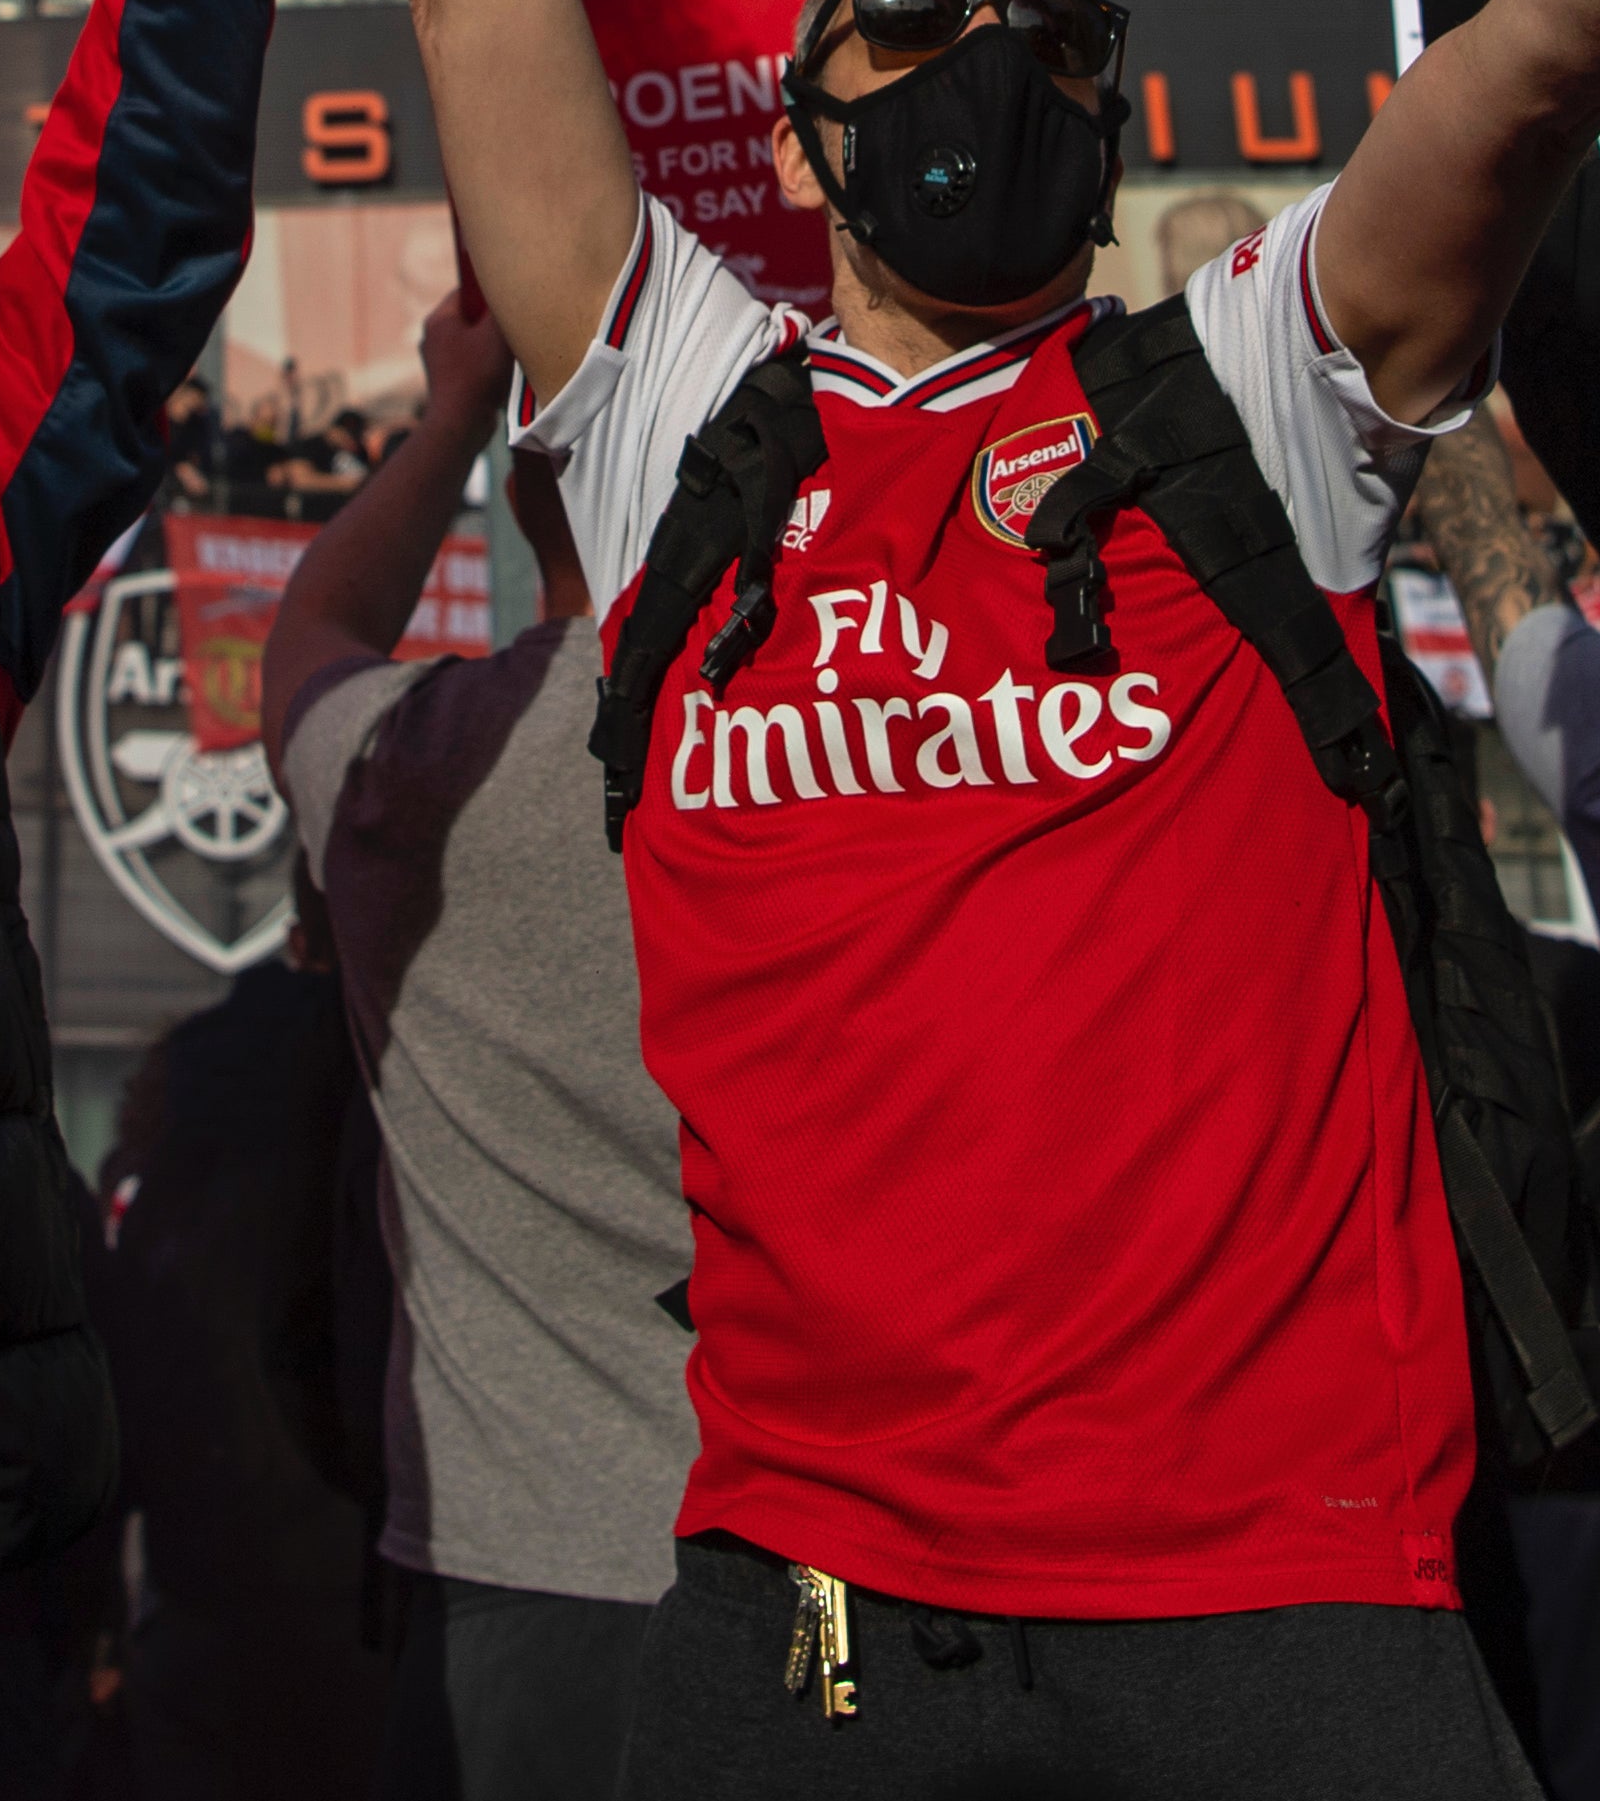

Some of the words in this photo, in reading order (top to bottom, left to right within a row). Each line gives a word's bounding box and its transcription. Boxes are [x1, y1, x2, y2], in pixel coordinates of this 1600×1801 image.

[658, 139, 737, 181] FOR
[694, 182, 769, 224] SAY
[989, 431, 1080, 483] Arsenal
[808, 579, 950, 681] Fly
[670, 666, 1172, 811] Emirates
